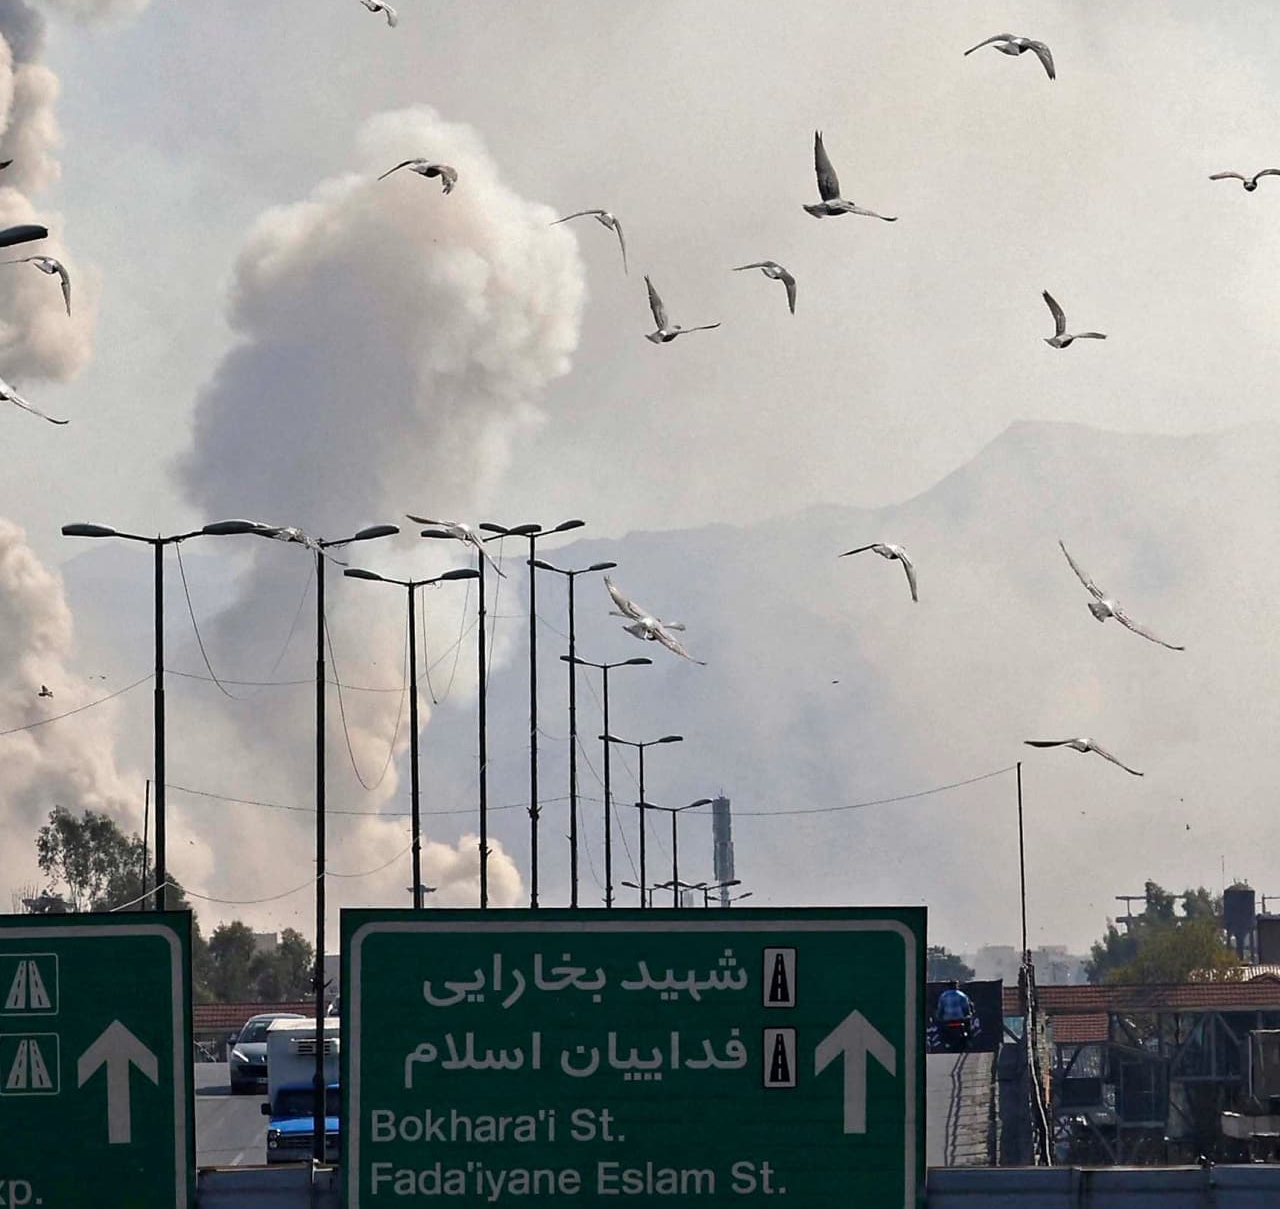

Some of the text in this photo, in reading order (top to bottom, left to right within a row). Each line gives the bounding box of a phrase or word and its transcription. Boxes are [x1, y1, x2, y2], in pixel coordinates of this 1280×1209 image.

[423, 949, 747, 1008] شهید بخارایی
[404, 1028, 747, 1088] فداییان اسلام
[371, 1109, 625, 1142] Bokhara'i St.
[371, 1161, 786, 1202] Fada'iyane Eslam St.
